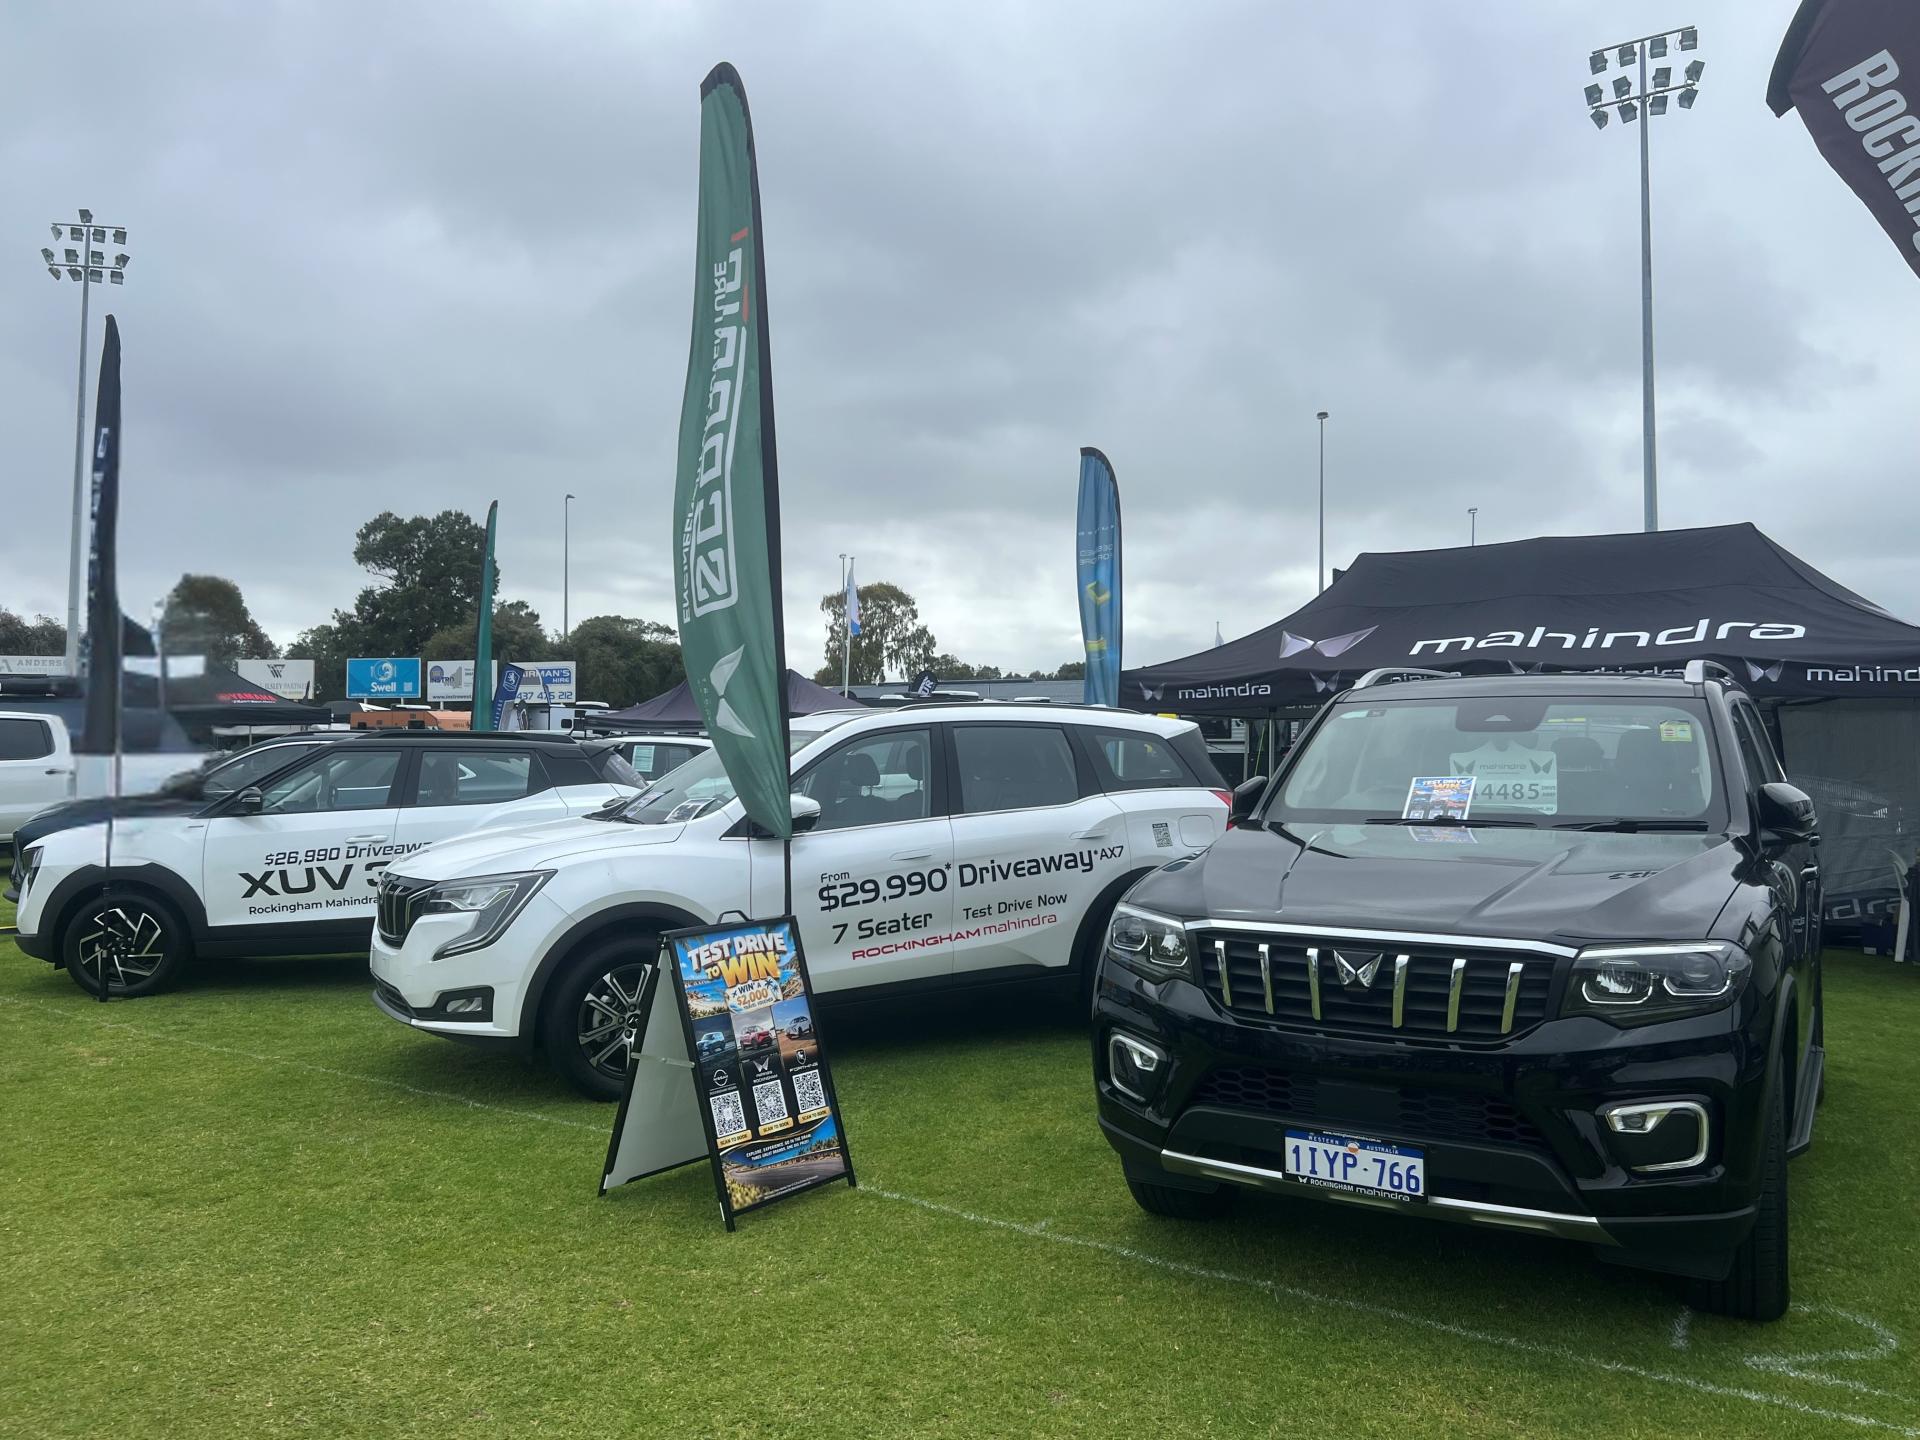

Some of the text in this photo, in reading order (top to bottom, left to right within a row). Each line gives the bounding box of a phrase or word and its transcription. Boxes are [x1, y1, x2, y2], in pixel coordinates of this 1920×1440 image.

[1820, 49, 1920, 253] ROCK
[1409, 619, 1806, 655] mahindra
[371, 682, 397, 692] Swell
[558, 691, 573, 699] 212
[1178, 683, 1271, 700] mahindra
[1479, 761, 1527, 771] mahindra
[265, 842, 433, 866] $26,990 Driveaw
[1099, 845, 1124, 861] AX7
[238, 863, 354, 899] XUV
[820, 872, 850, 883] From
[249, 896, 378, 915] Rockingham Mahindra
[963, 893, 1067, 920] Test Drive Now
[832, 912, 933, 945] 7 Seater
[852, 913, 1057, 960] ROCKINGHAM mahindra
[688, 932, 787, 972] TEST DRIVE
[705, 966, 720, 979] TO
[737, 988, 768, 1006] $2,000
[1308, 1135, 1398, 1155] WESTERN AUSTRALIA
[1310, 1178, 1410, 1202] ROCKINGHAM mahindra
